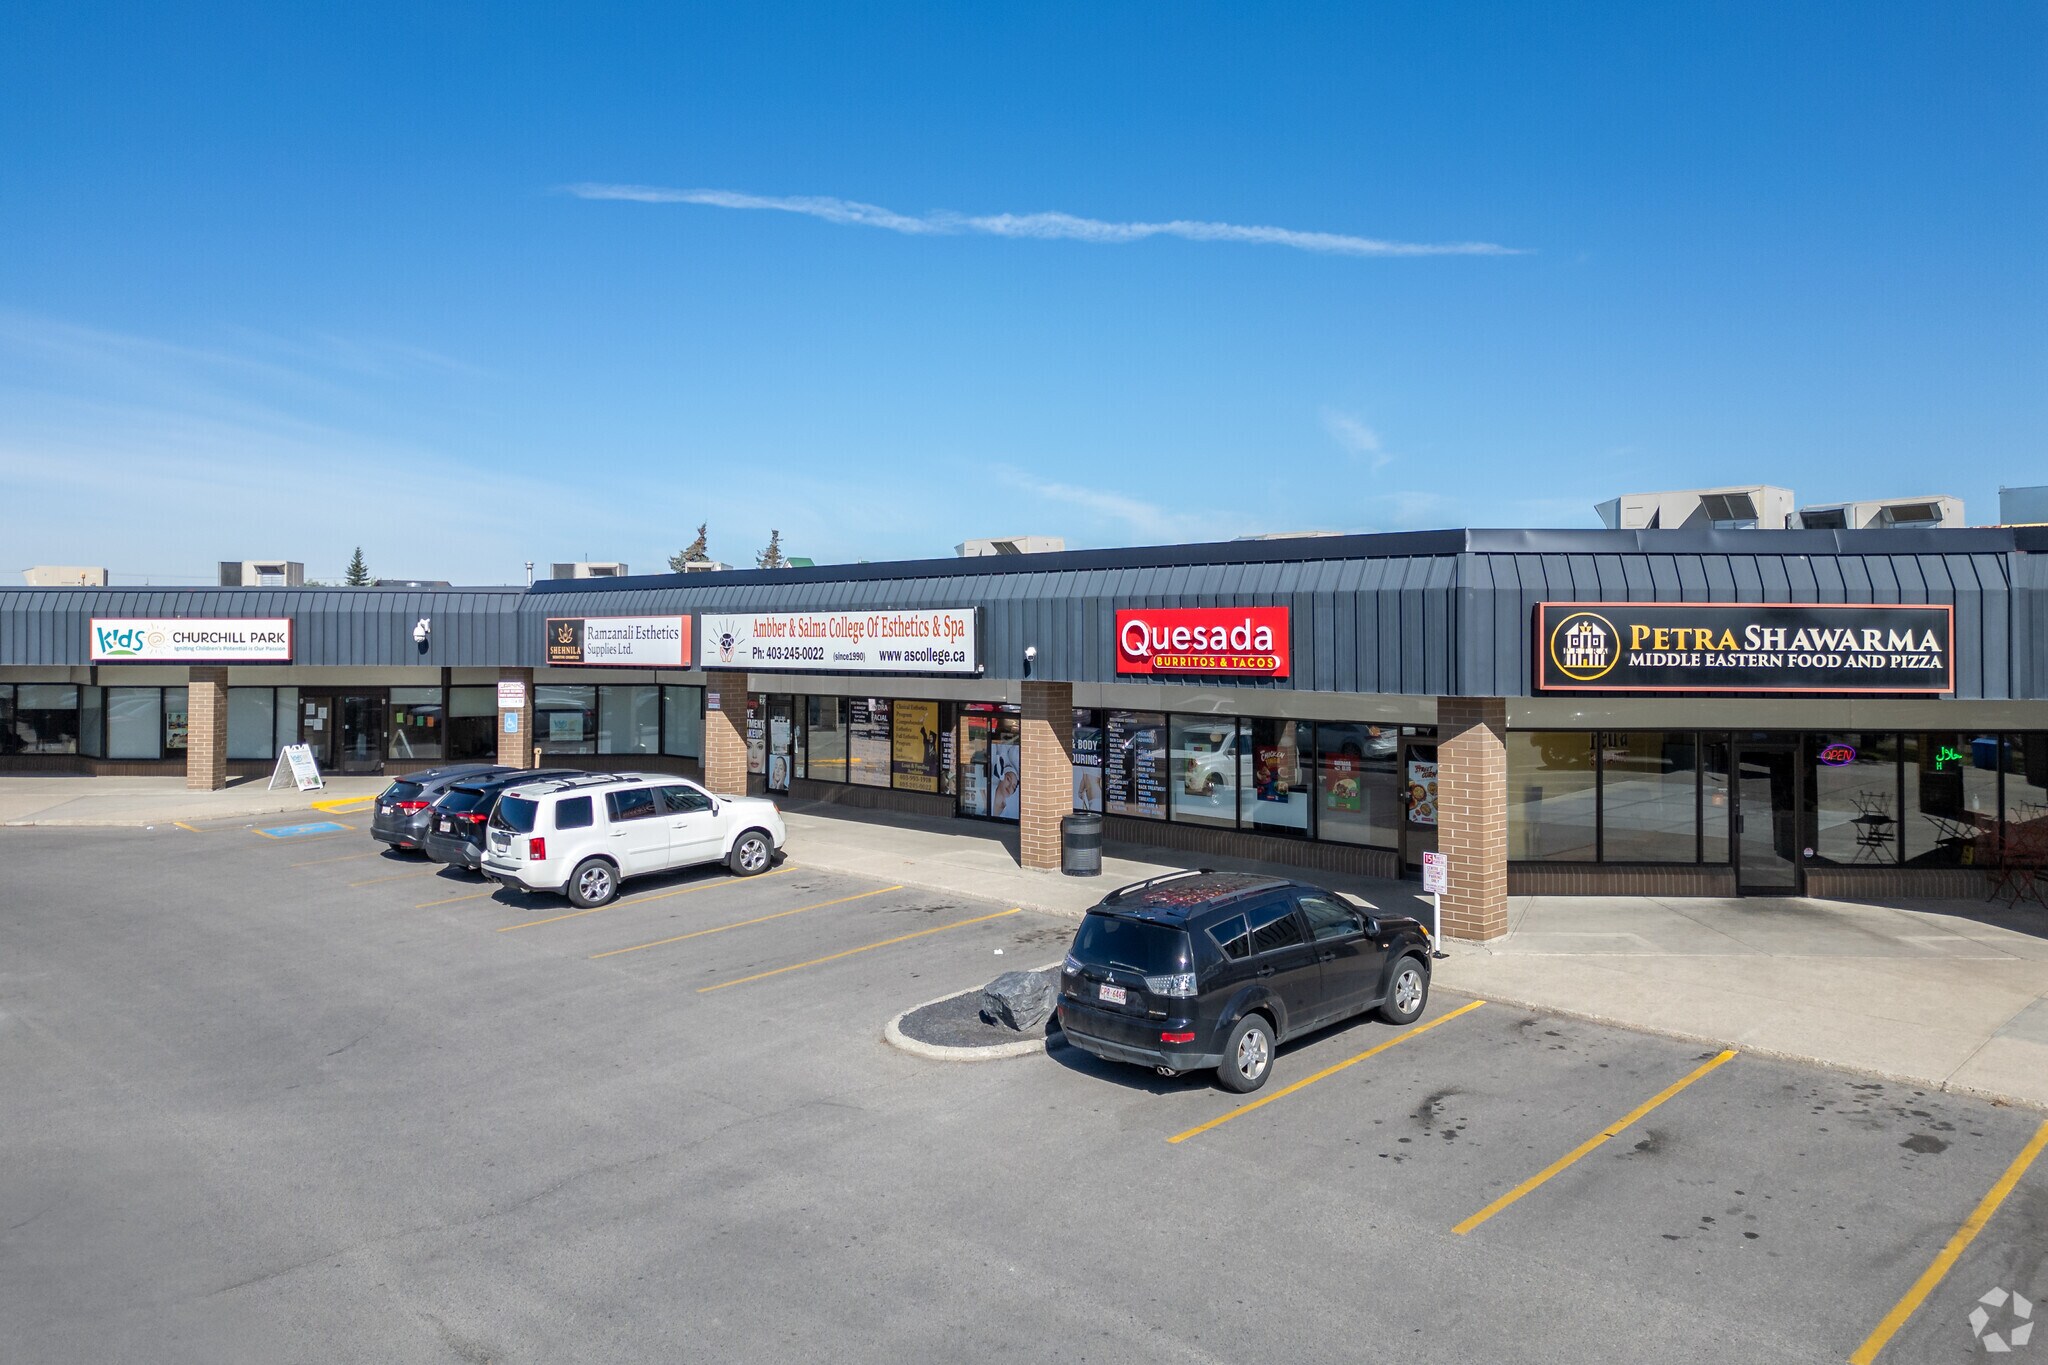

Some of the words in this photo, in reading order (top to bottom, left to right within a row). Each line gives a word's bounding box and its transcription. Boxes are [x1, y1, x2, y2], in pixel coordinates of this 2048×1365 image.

[587, 625, 634, 640] Ramzanali
[636, 624, 679, 640] Esthetics
[753, 617, 786, 638] Ambber
[789, 617, 796, 638] &
[798, 617, 827, 638] Salma
[829, 616, 864, 644] College
[867, 615, 879, 638] Of
[881, 614, 929, 637] Esthetics
[933, 615, 941, 637] &
[944, 614, 965, 643] Spa
[173, 632, 246, 643] CHURCHILL
[250, 632, 286, 643] PARK
[1121, 618, 1273, 656] Quesada
[1629, 624, 1741, 651] PETRA
[1744, 624, 1942, 652] SHAWARMA
[550, 646, 581, 655] SHEHNILA
[587, 643, 617, 657] Supplies
[618, 643, 633, 655] Ltd.
[752, 646, 765, 660] Ph:
[766, 647, 824, 660] 403-245-0022
[1157, 657, 1215, 667] BURRITOS
[1220, 657, 1228, 667] &
[1232, 657, 1274, 668] TACOS
[1628, 652, 1700, 667] MIDDLE
[1704, 653, 1783, 667] EASTERN
[1787, 654, 1842, 668] FOOD
[1844, 654, 1886, 668] AND
[1890, 654, 1943, 669] PIZZA
[1077, 739, 1098, 751] BODY
[1823, 749, 1852, 761] OPEN
